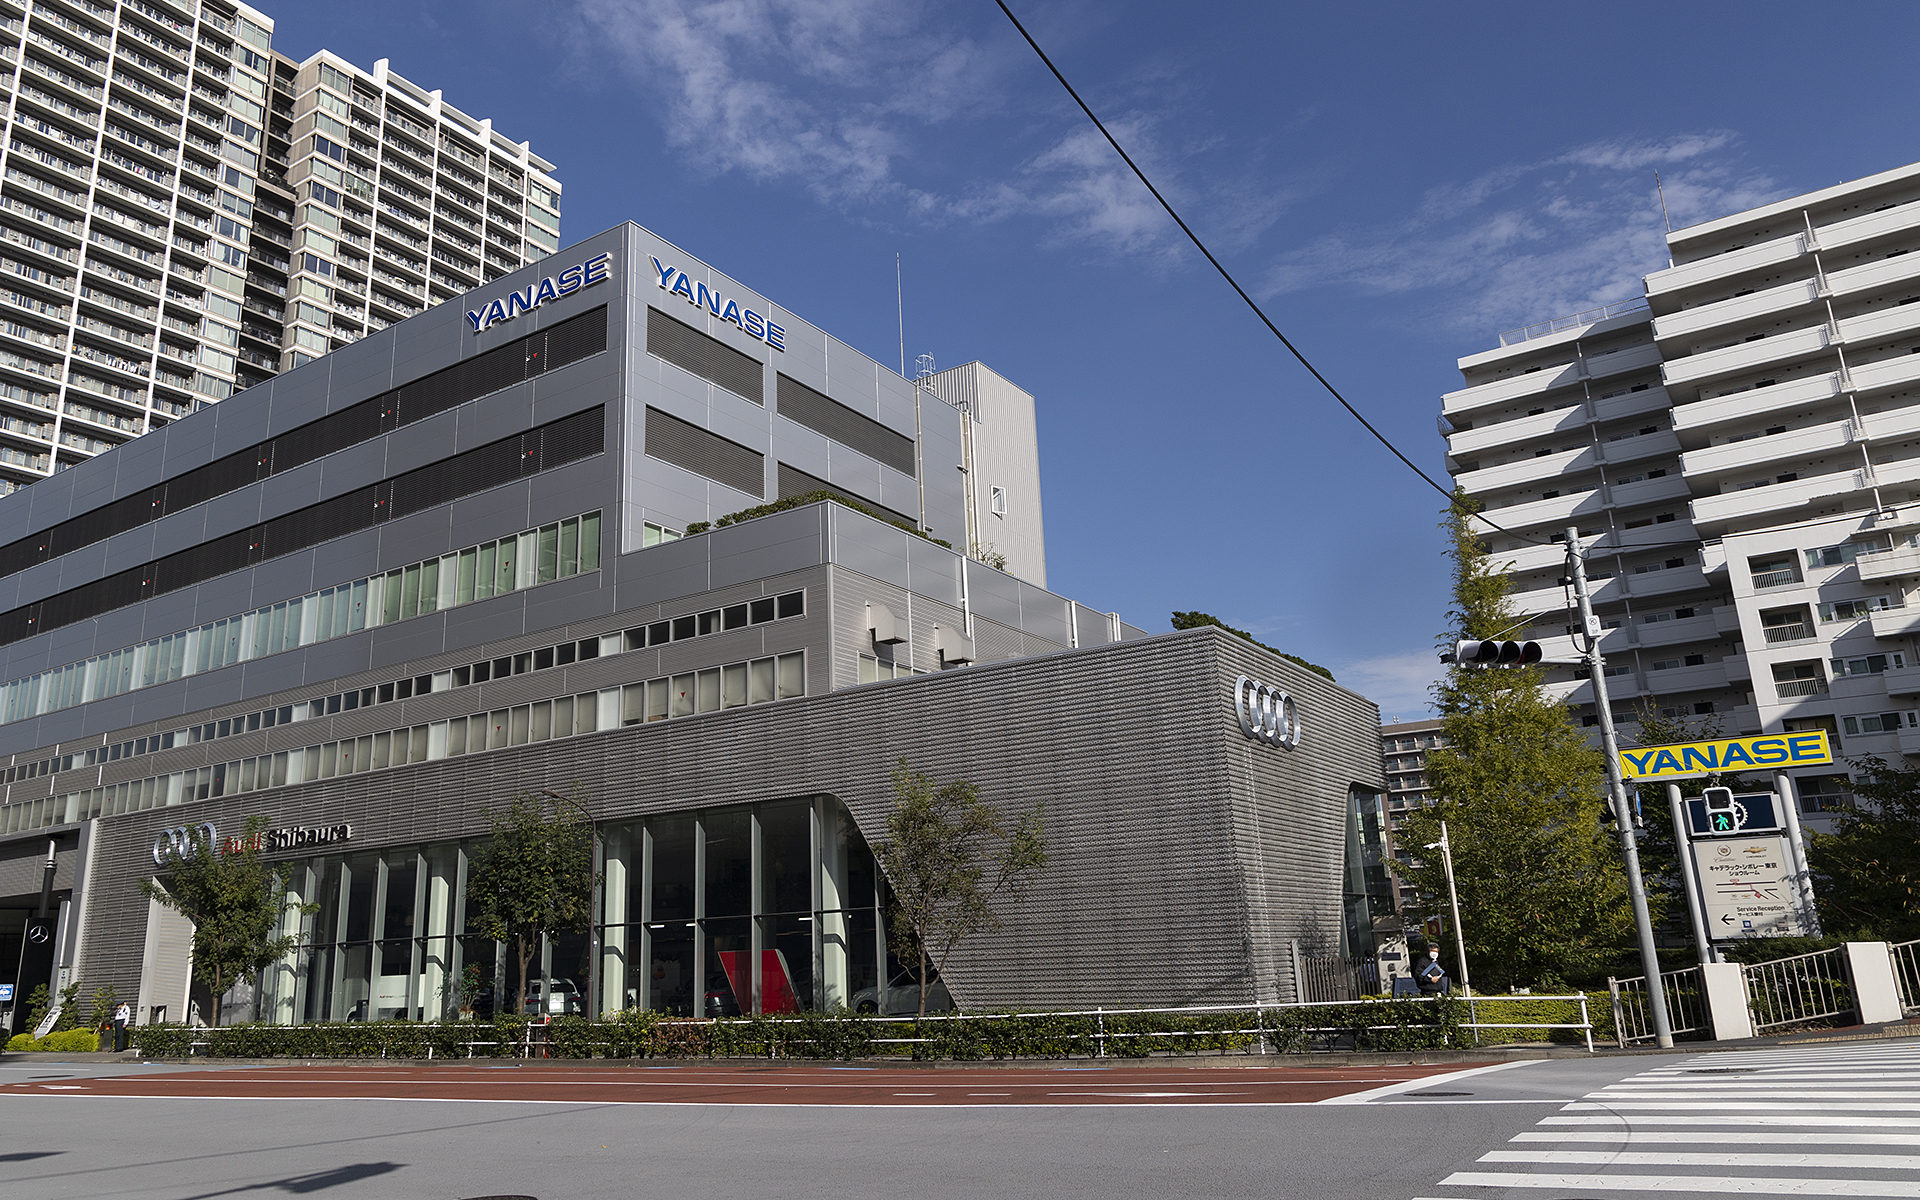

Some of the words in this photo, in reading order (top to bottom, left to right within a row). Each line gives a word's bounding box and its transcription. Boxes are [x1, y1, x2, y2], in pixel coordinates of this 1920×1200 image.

[466, 252, 612, 332] YANASE
[649, 254, 787, 351] YANASE
[1622, 735, 1826, 775] YANASE
[266, 824, 351, 850] Shibaura
